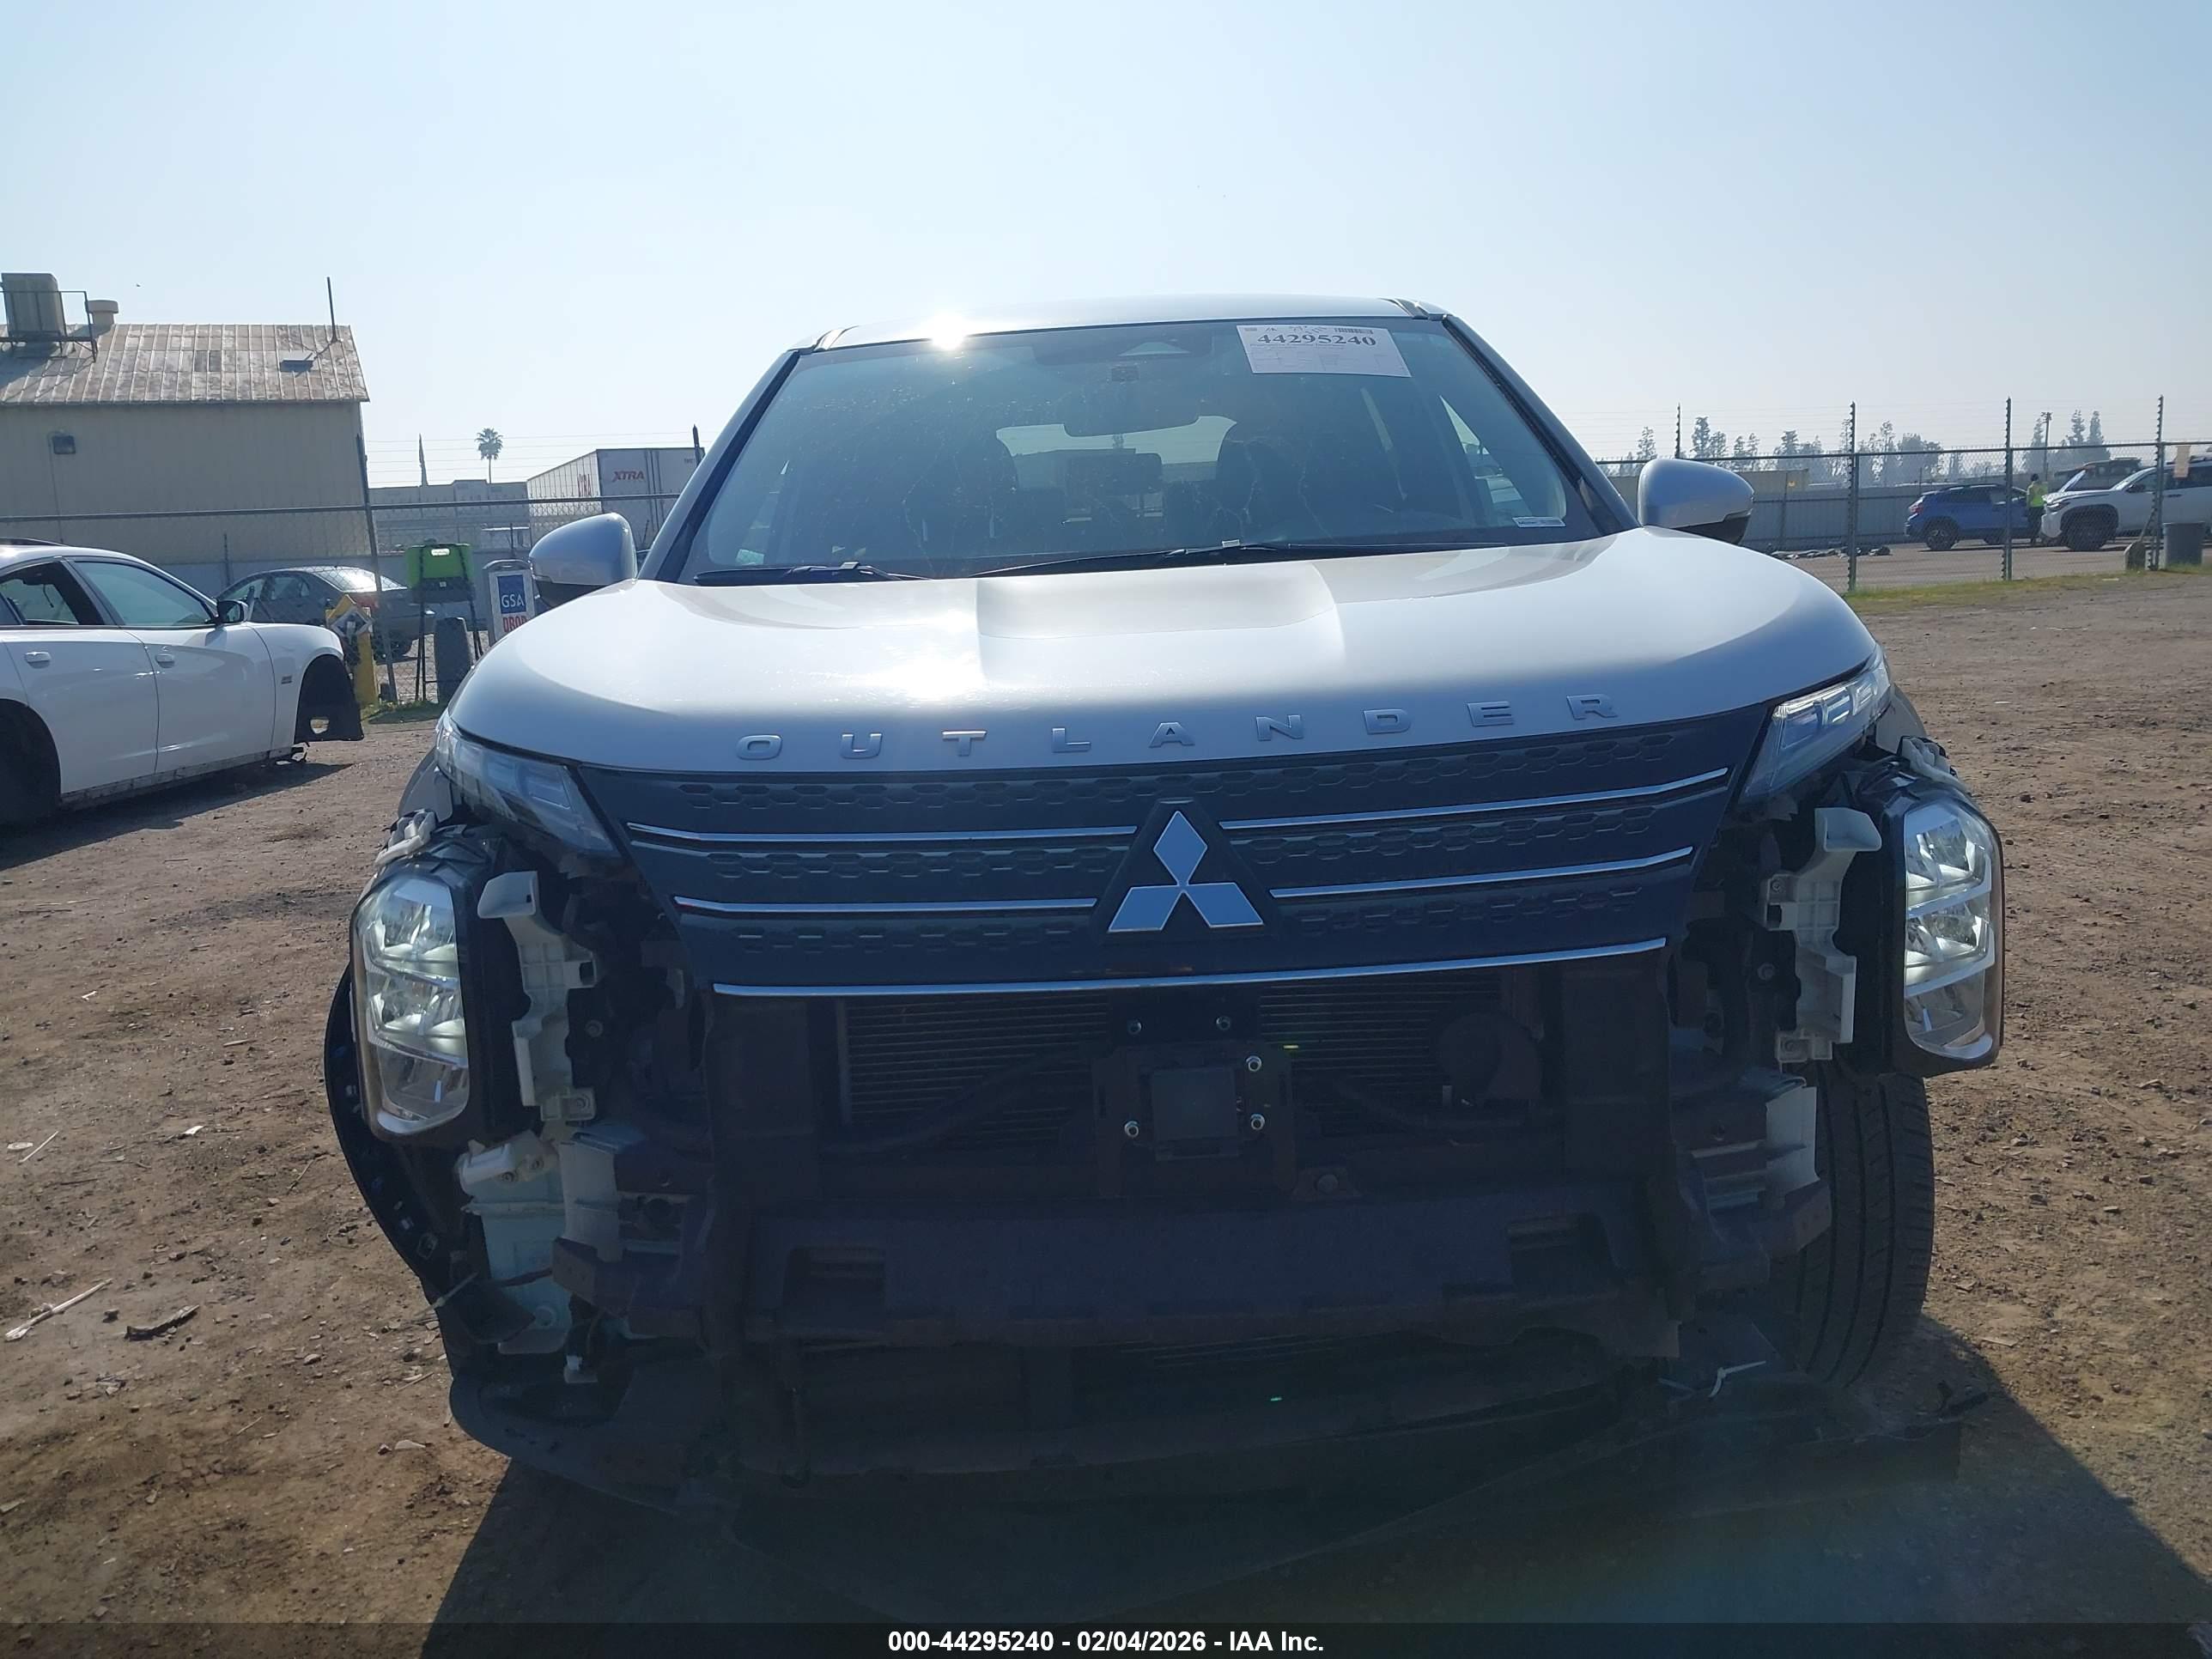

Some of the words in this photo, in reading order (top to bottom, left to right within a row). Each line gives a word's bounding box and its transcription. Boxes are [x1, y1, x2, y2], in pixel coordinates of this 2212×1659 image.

[1257, 334, 1376, 346] 44295240
[611, 470, 645, 483] XTRA
[501, 593, 525, 608] GSA
[736, 693, 1619, 761] OUTLANDER
